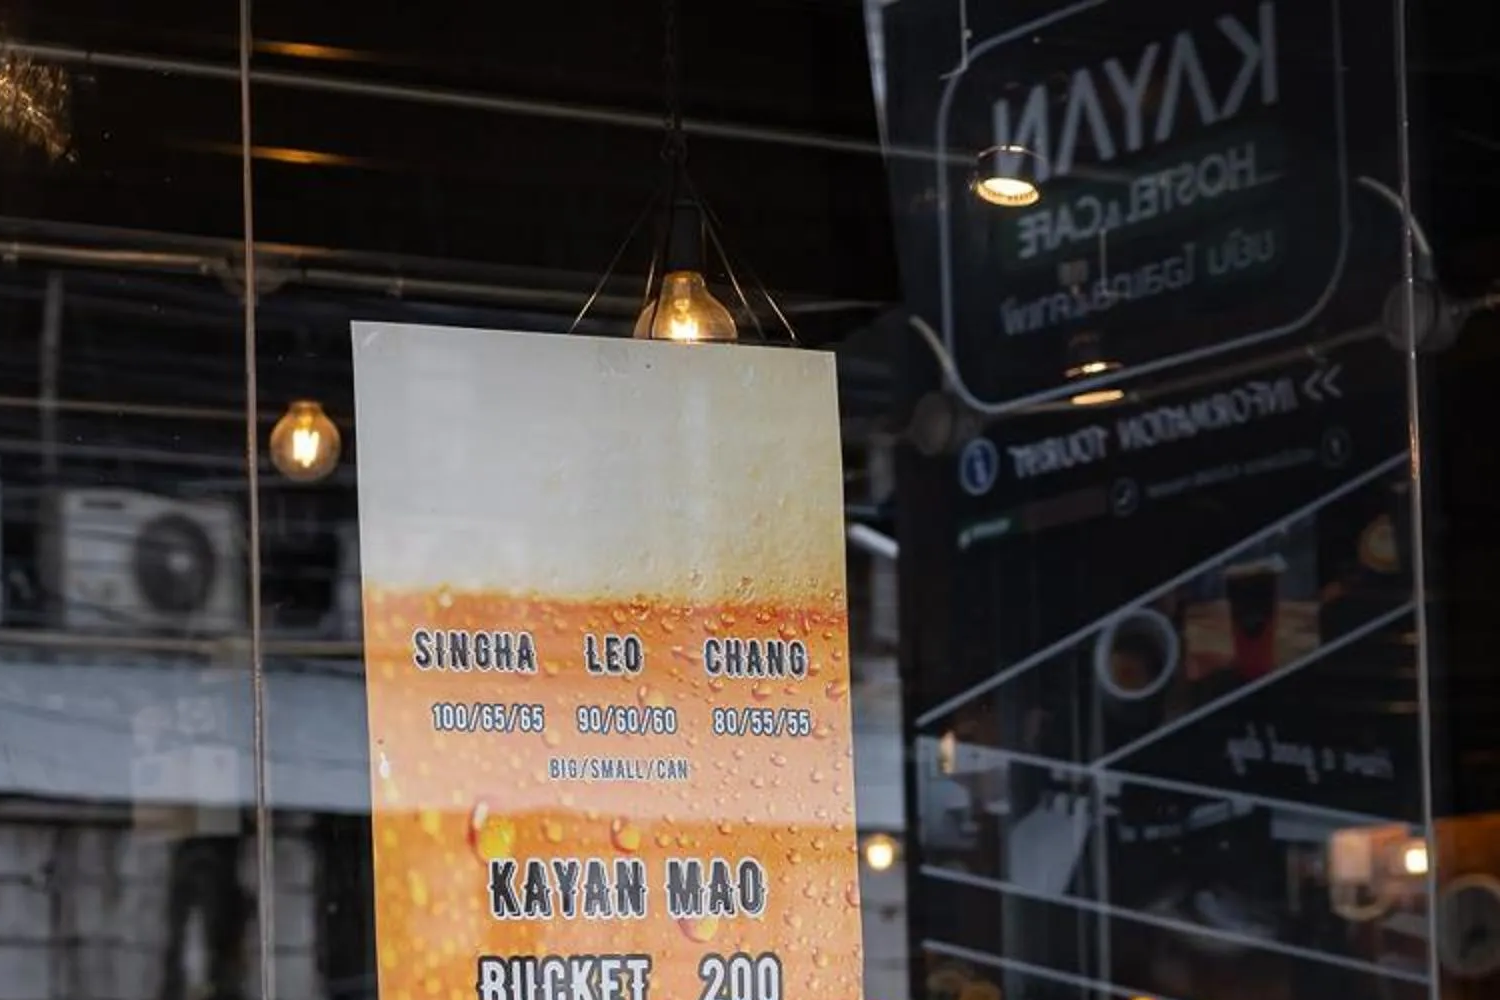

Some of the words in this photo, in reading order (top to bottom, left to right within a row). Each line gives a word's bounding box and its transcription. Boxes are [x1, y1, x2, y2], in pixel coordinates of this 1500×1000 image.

[413, 629, 537, 673] SINGHA
[585, 634, 643, 675] LEO
[704, 637, 807, 679] CHANG
[432, 703, 544, 732] 100/65/65
[577, 706, 677, 735] 90/60/60
[713, 708, 811, 737] 80/55/55
[549, 757, 688, 780] BIG/SMALL/CAN
[489, 858, 647, 917] KAYAN
[666, 858, 767, 917] MAO
